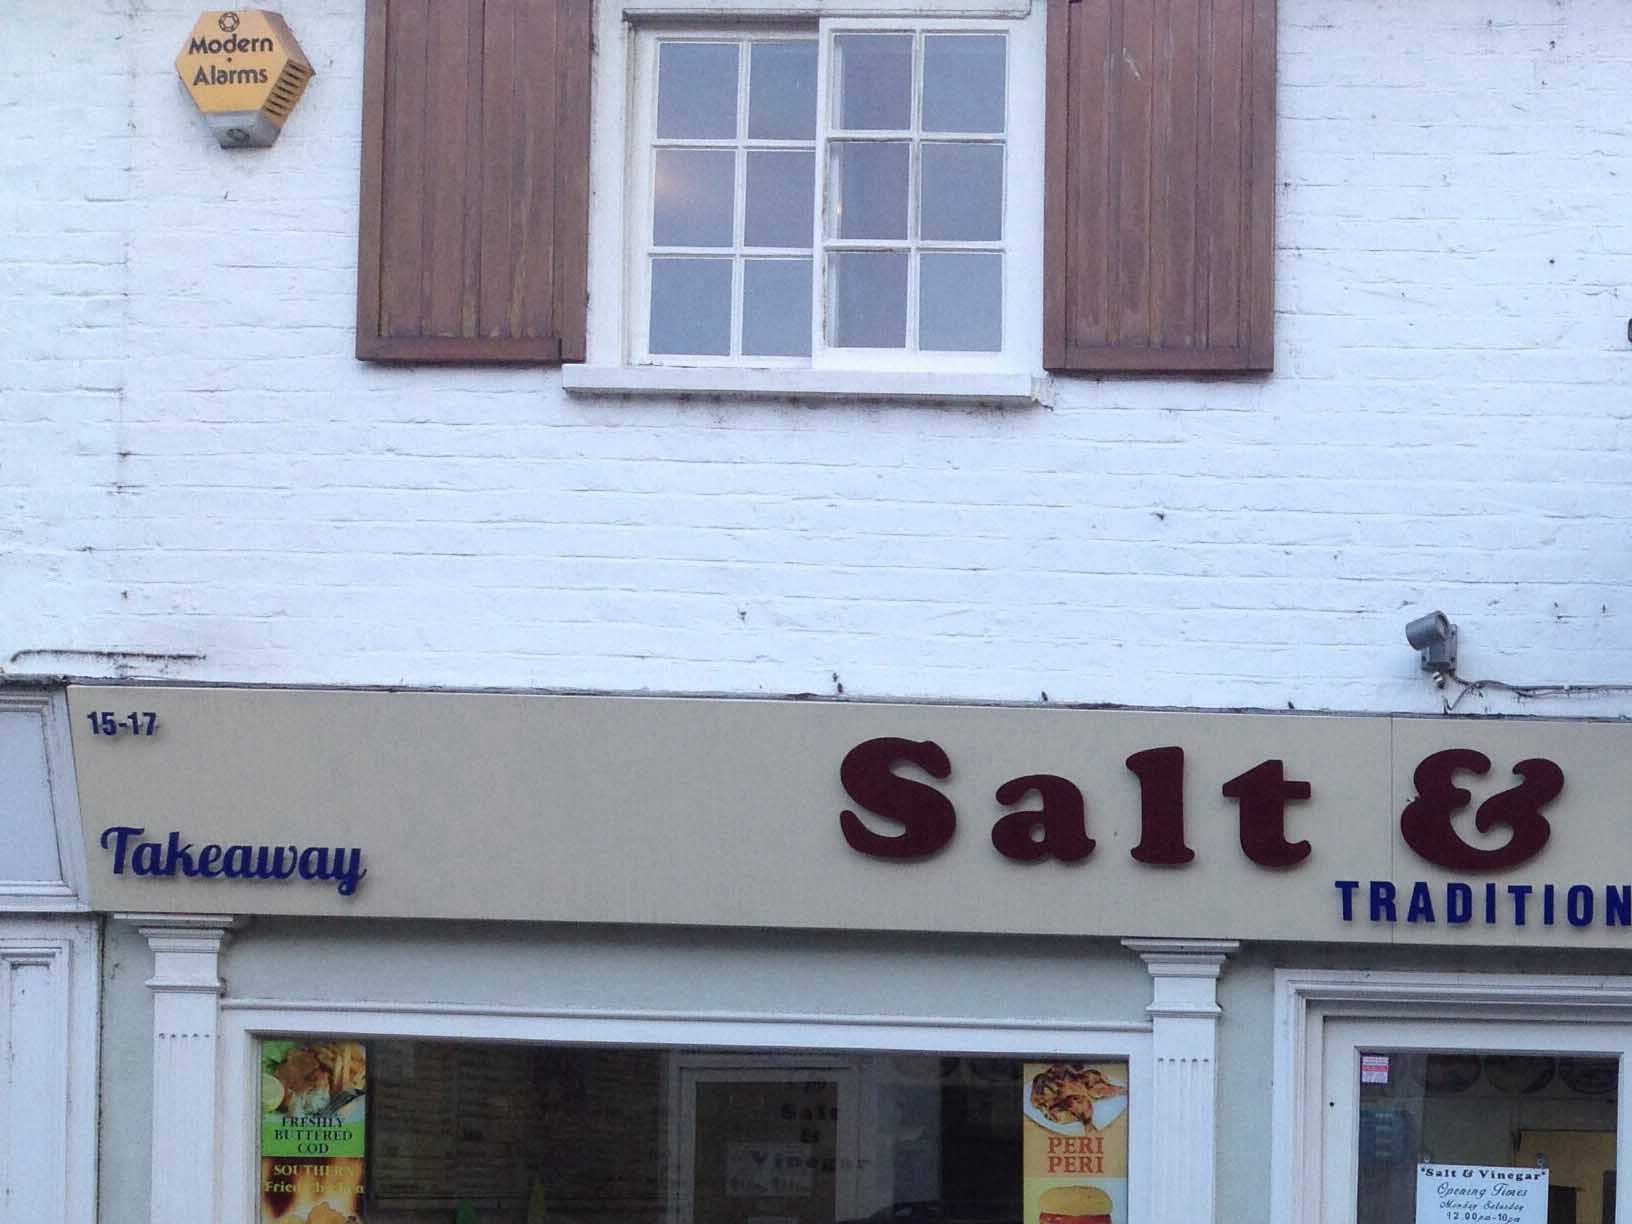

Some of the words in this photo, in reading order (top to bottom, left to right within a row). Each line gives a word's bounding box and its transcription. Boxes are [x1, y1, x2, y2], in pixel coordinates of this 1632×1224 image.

[189, 34, 273, 54] Modern
[193, 65, 268, 86] Alarms
[86, 710, 158, 737] 15-17
[839, 737, 1311, 868] Salt
[1401, 748, 1565, 874] &
[100, 825, 367, 896] Takeaway
[297, 1142, 329, 1154] COD
[1048, 1136, 1105, 1154] PERI
[1048, 1155, 1105, 1173] PERI
[1437, 1182, 1487, 1199] Opening
[1490, 1183, 1528, 1197] Times
